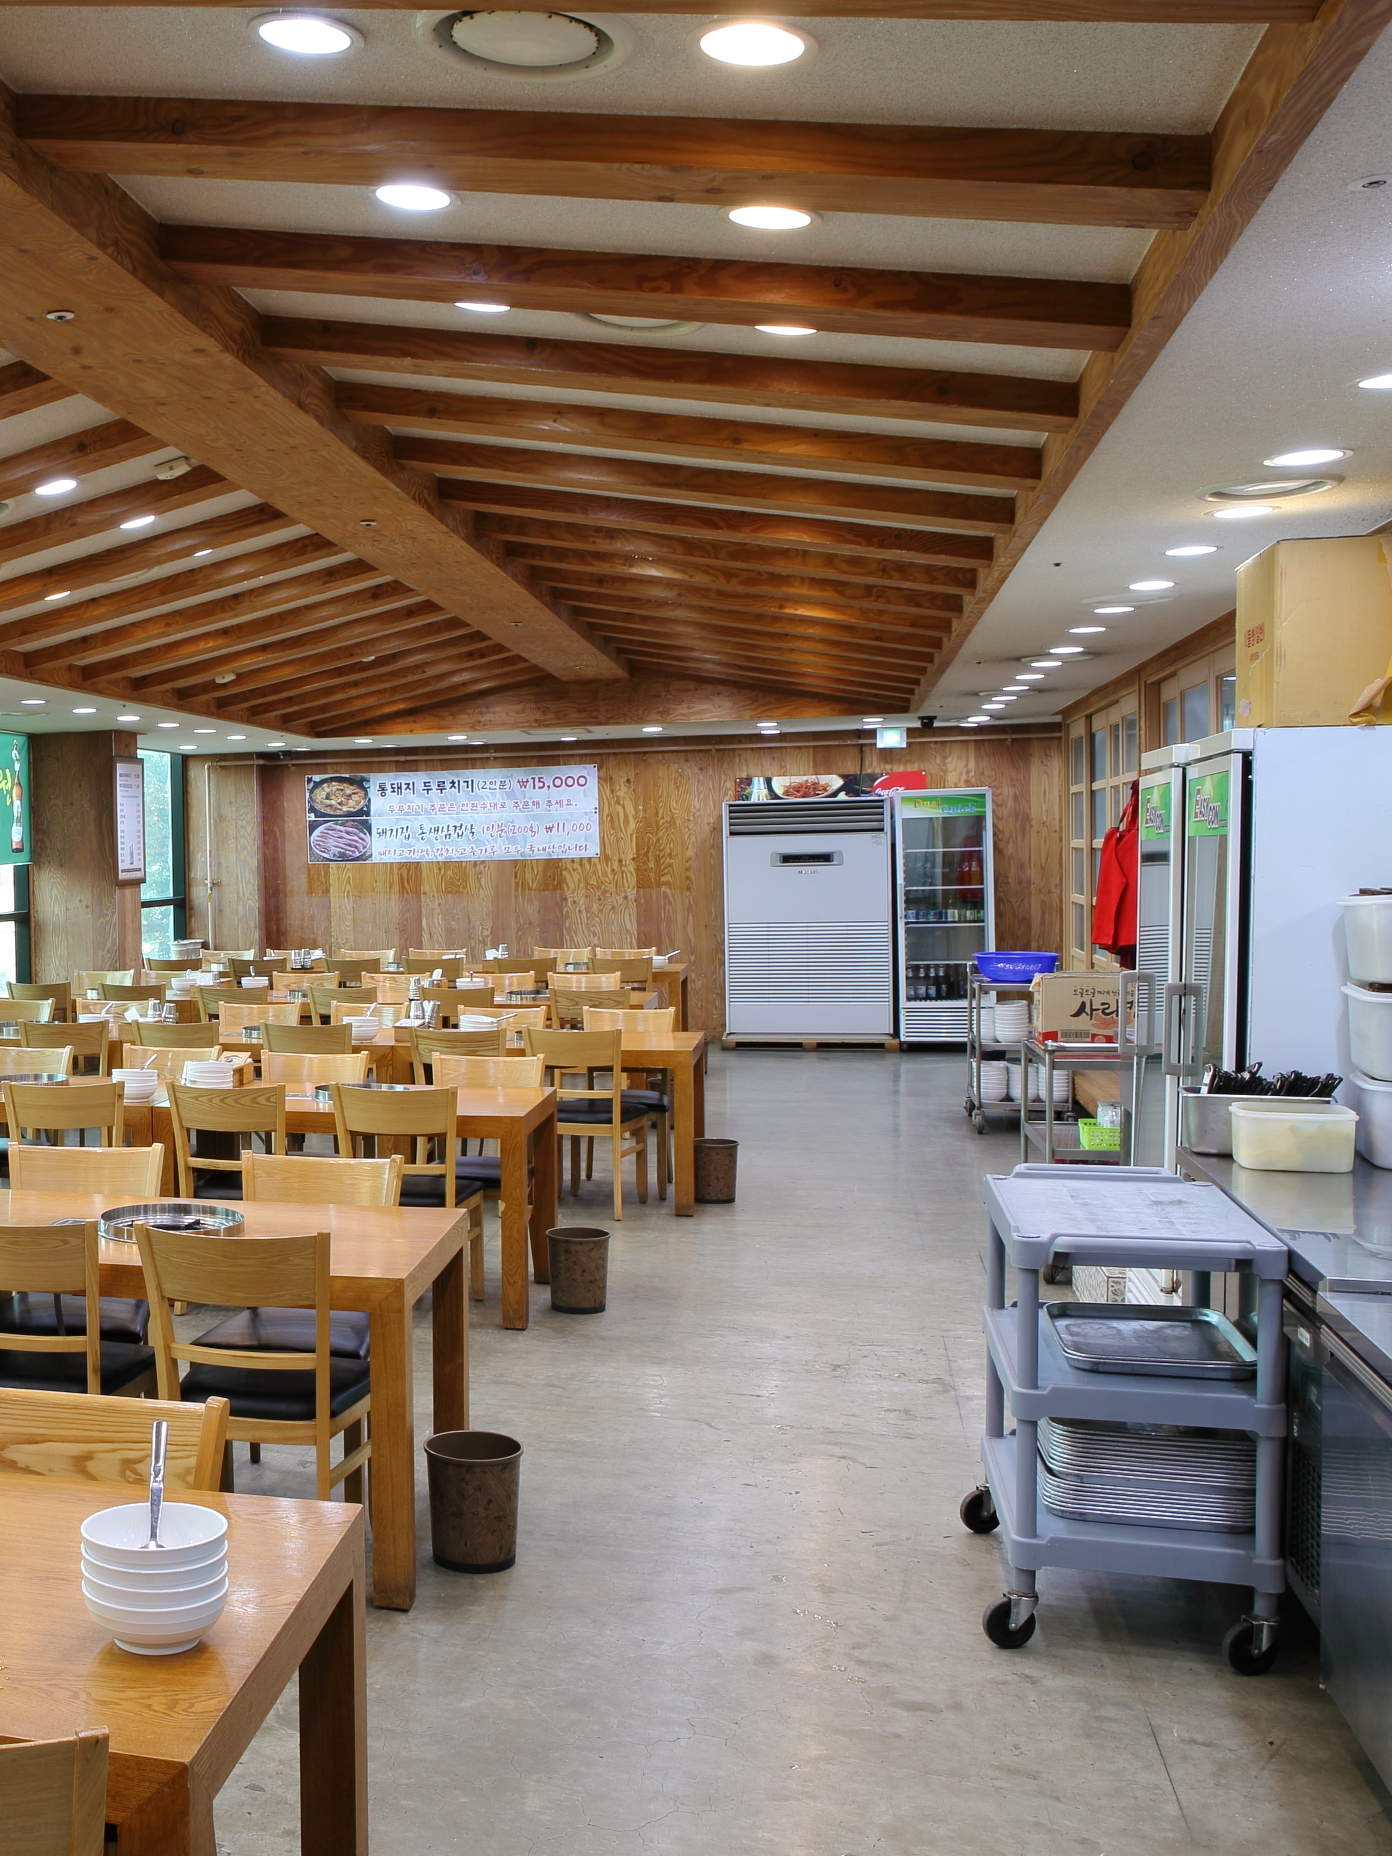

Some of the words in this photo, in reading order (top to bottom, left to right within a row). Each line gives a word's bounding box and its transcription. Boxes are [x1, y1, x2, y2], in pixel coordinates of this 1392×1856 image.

[377, 780, 416, 797] 통돼지
[388, 803, 424, 813] 두루치기
[429, 802, 456, 813] 주문은
[461, 801, 507, 811] 인원수대로
[512, 800, 540, 810] 주문해
[545, 799, 578, 808] 주세요.
[913, 798, 941, 808] Dual
[940, 804, 975, 815] Quick
[376, 825, 410, 841] 돼지집
[418, 823, 475, 841] 통생삼겹살
[503, 845, 522, 855] 모두
[1072, 986, 1096, 998] 보글보글
